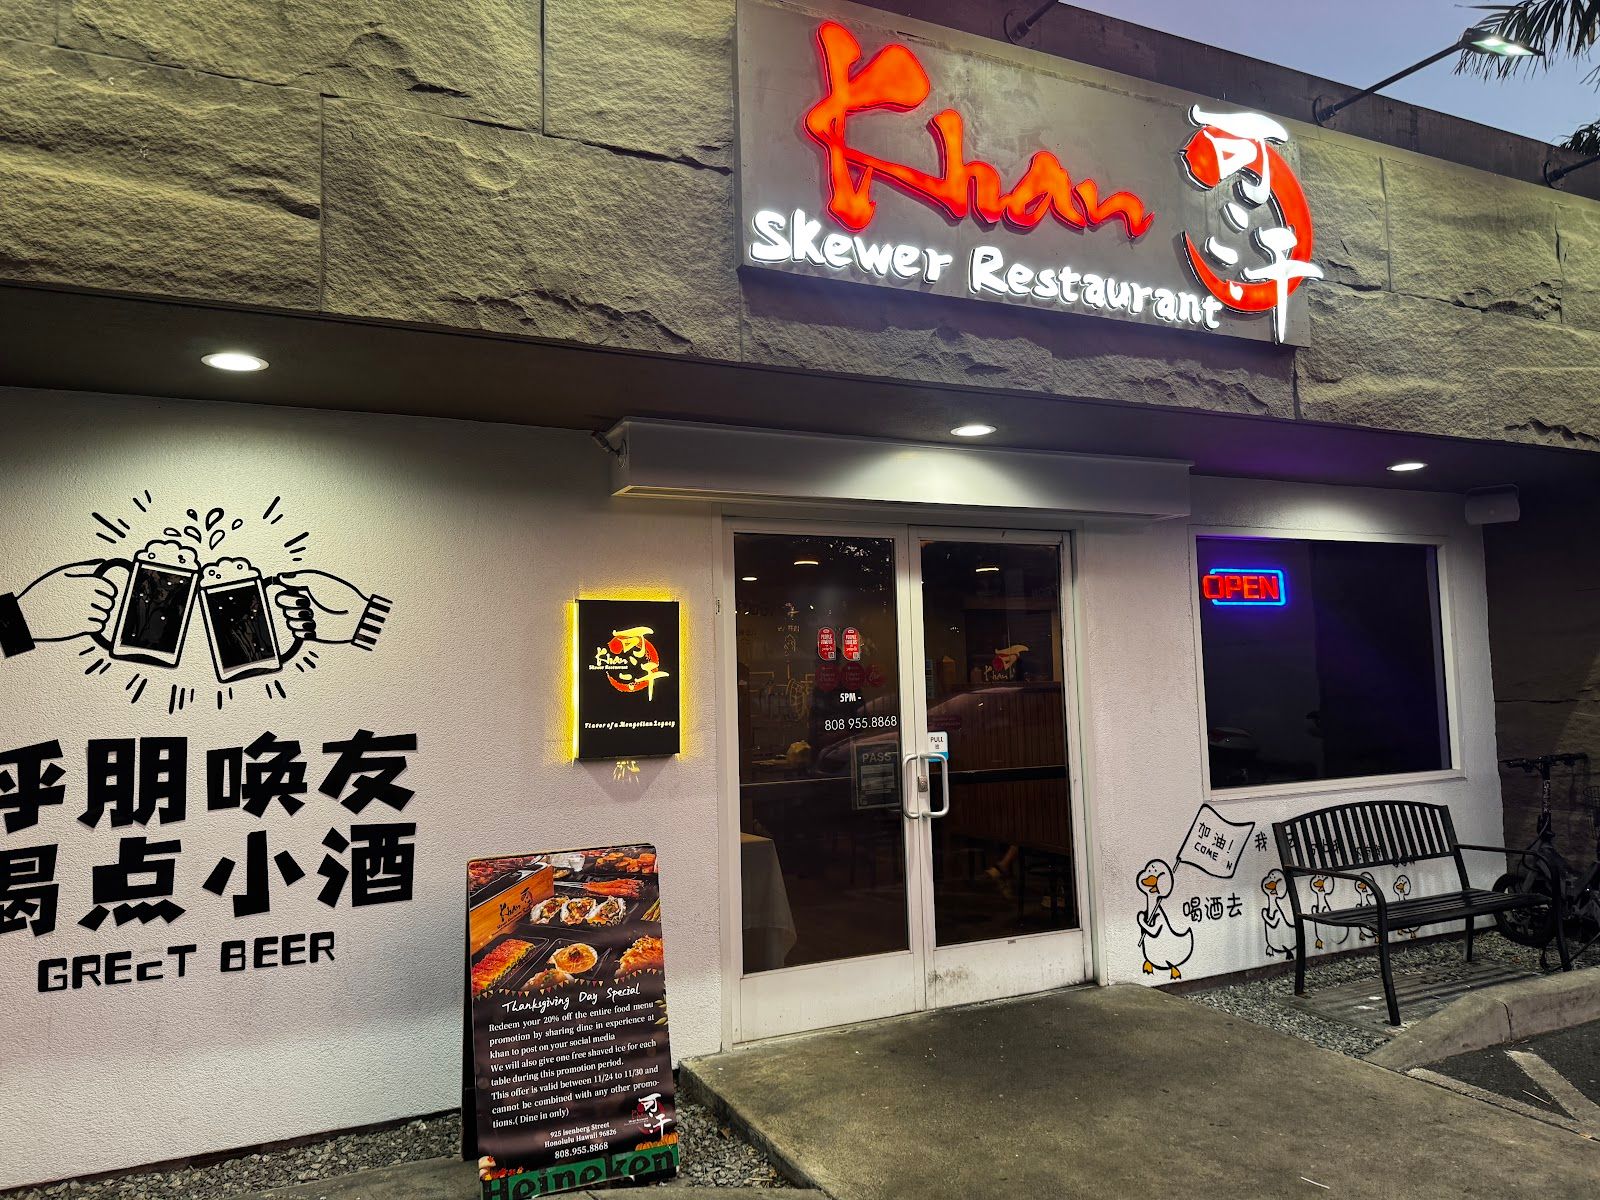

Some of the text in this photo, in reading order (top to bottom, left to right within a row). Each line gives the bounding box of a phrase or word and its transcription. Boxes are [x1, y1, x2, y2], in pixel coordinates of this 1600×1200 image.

[803, 20, 1155, 239] Khan
[1187, 103, 1324, 345] 可汗
[750, 208, 1223, 331] Skewer Restaurant
[1202, 575, 1279, 599] OPEN
[595, 646, 628, 666] Khan
[613, 626, 670, 701] 可汗
[840, 692, 856, 702] 5PM
[824, 715, 897, 731] 808 955.8868
[862, 751, 892, 763] PASS
[1194, 842, 1219, 861] COME
[1183, 892, 1243, 922] 喝酒去
[220, 931, 335, 973] BEER
[501, 982, 640, 1013] Thanksgiving Day Special
[489, 1002, 654, 1032] Redeem your 20% off the entire food menu
[489, 1033, 531, 1047] promotion
[533, 1030, 543, 1040] by
[545, 1027, 574, 1037] sharing
[576, 1023, 593, 1032] dine
[595, 1021, 603, 1029] in
[605, 1016, 646, 1029] experience
[490, 1050, 510, 1059] khan
[511, 1048, 520, 1056] to
[521, 1045, 537, 1056] post
[550, 1041, 568, 1052] your
[569, 1036, 591, 1046] social
[592, 1033, 616, 1043] media
[490, 1064, 504, 1072] We
[505, 1060, 520, 1070] will
[521, 1059, 537, 1068] also
[539, 1056, 555, 1067] give
[571, 1051, 587, 1060] free
[587, 1046, 614, 1057] shaved
[615, 1044, 626, 1053] ice
[627, 1042, 639, 1051] for
[639, 1038, 657, 1049] each
[491, 1057, 624, 1087] table during this promotion period.
[491, 1064, 659, 1101] This offer is valid between 11/24 to 11/30 and
[491, 1080, 660, 1115] cannot be combined with any other promo-
[520, 1114, 539, 1124] Dine
[540, 1111, 548, 1120] in
[549, 1107, 570, 1119] only)
[550, 1130, 562, 1139] 925
[591, 1121, 610, 1131] Street
[544, 1136, 575, 1148] Honolulu
[554, 1141, 609, 1159] 808.955.8868
